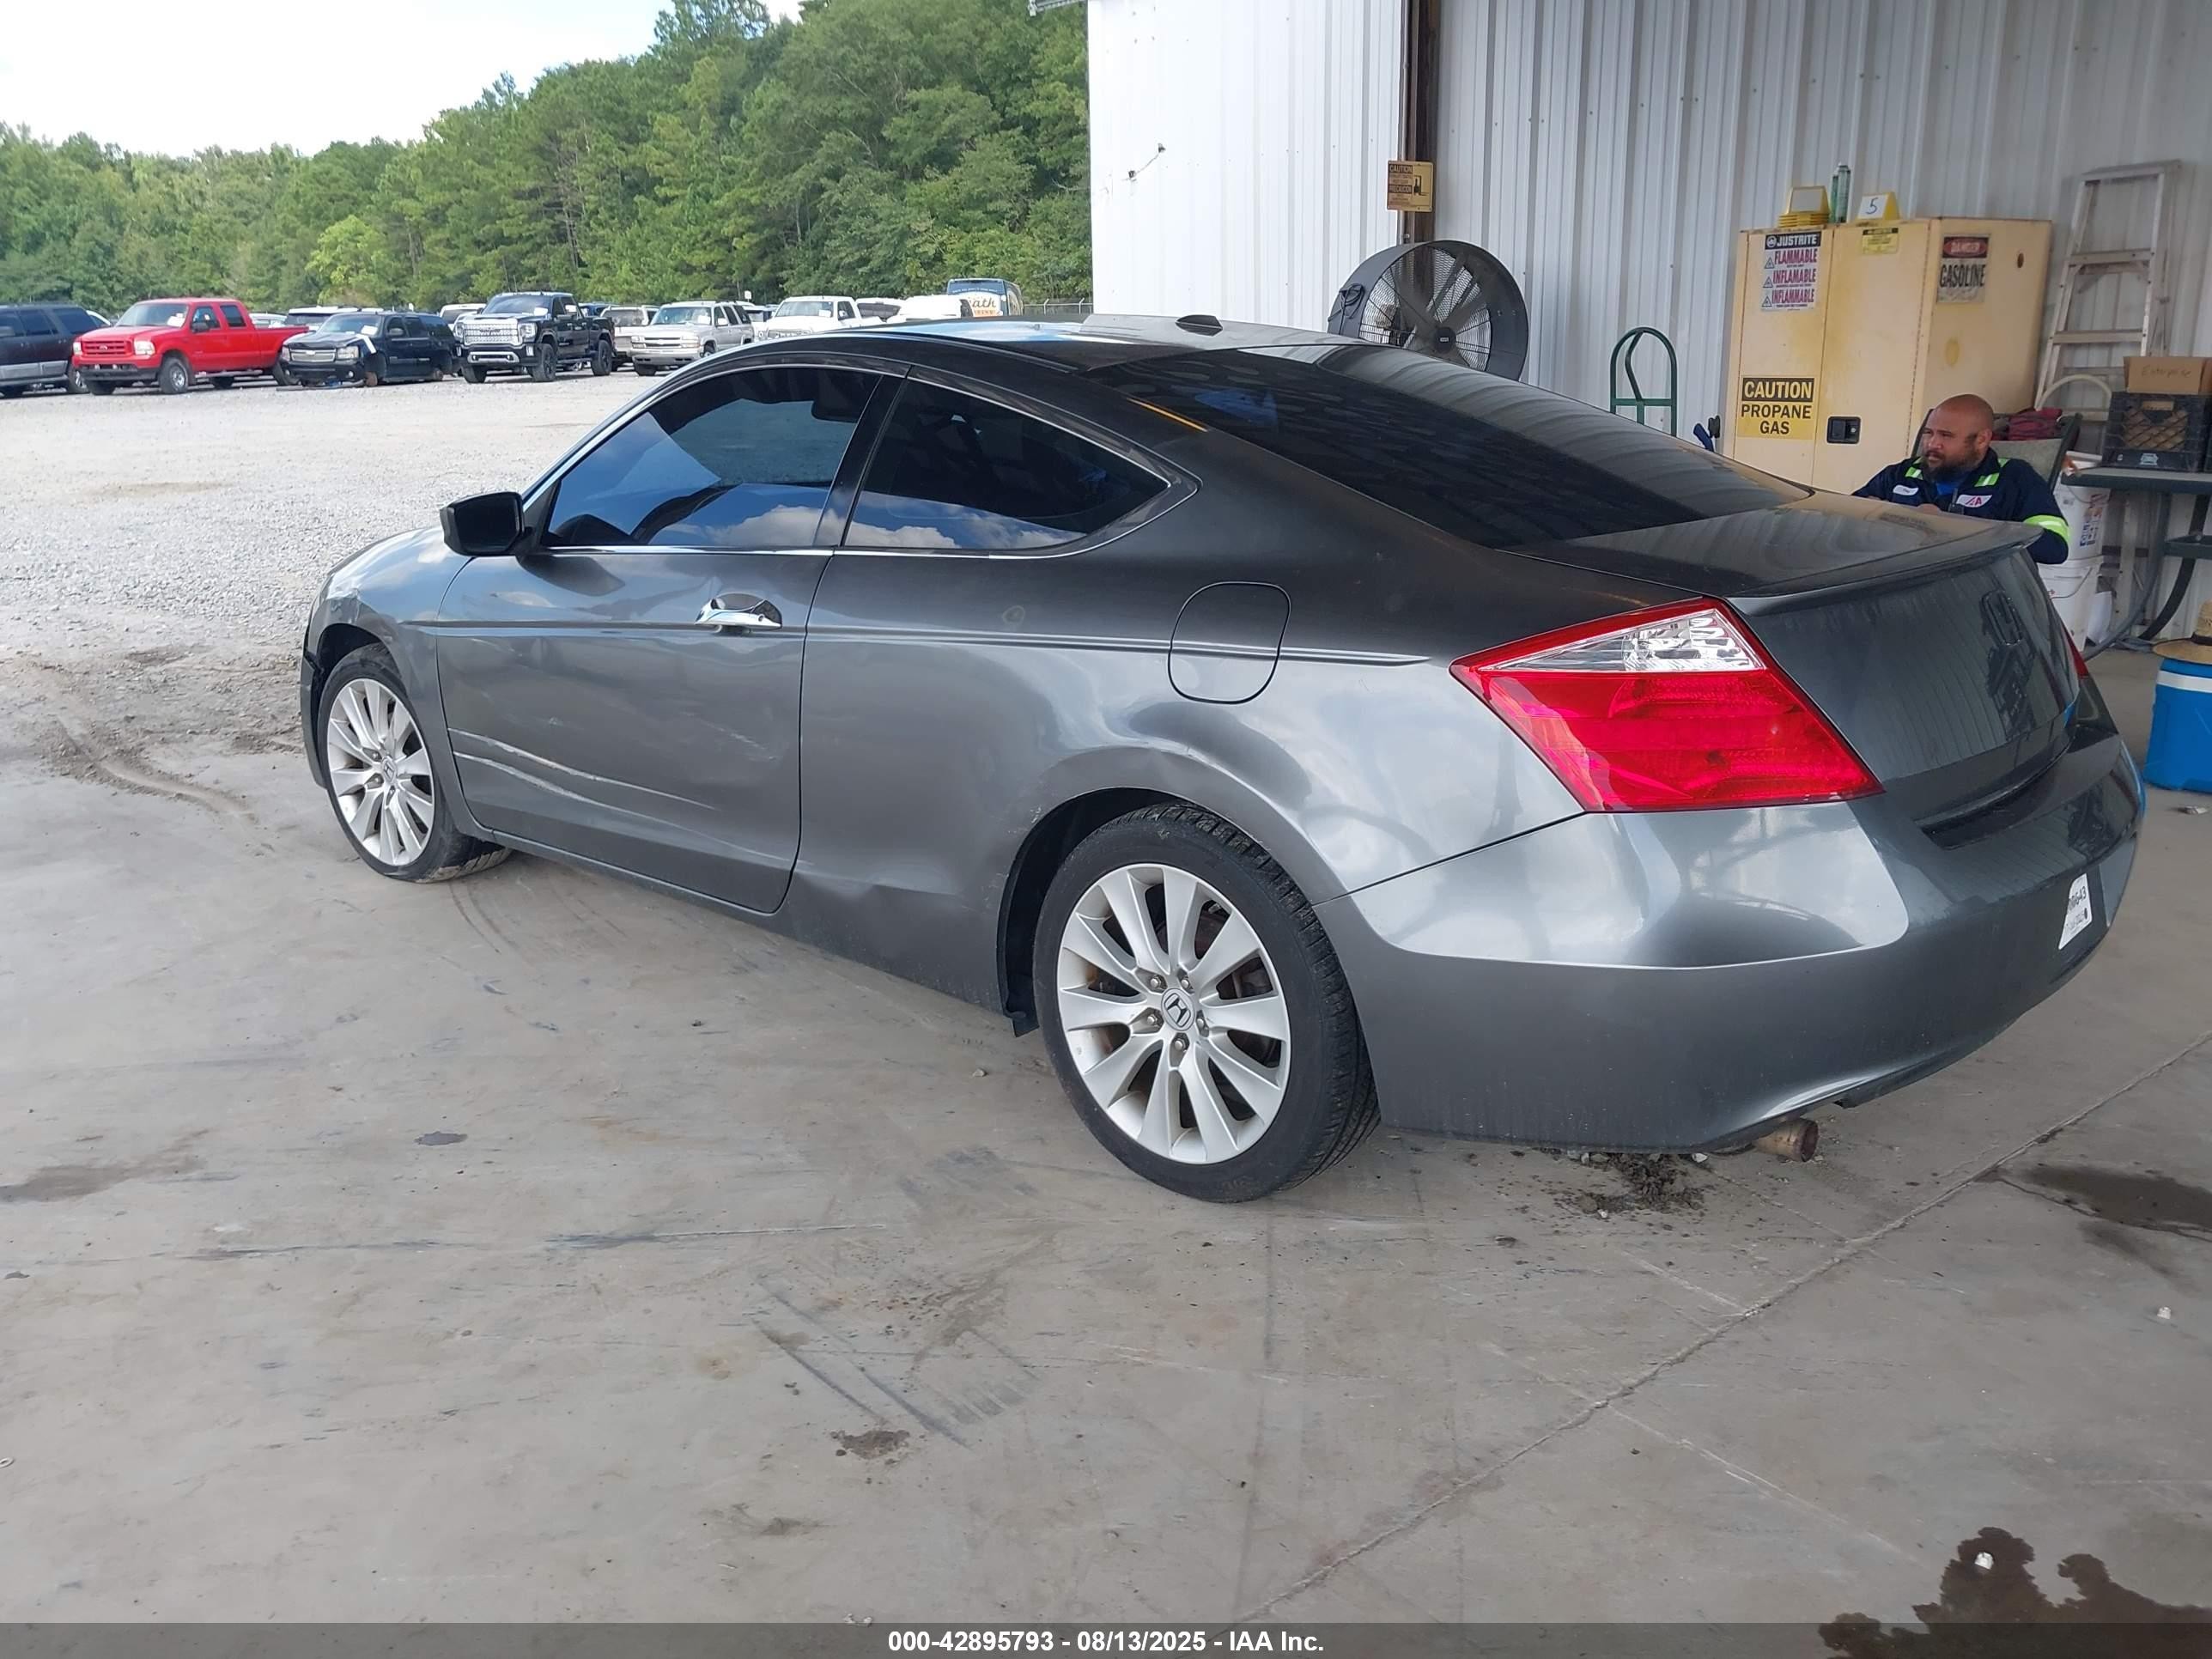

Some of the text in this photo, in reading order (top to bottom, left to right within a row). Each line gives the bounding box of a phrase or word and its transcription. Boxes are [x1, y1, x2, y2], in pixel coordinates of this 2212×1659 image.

[1865, 197, 1879, 215] 5
[1777, 234, 1818, 246] JUSTRITE
[1774, 248, 1818, 264] FLAMMABLE
[1772, 268, 1817, 284] INFLAMABLE
[1940, 264, 1986, 288] GASOLINE
[969, 297, 997, 308] ath
[1771, 289, 1815, 304] INFLAMMABLE
[1744, 380, 1812, 399] CAUTION
[1741, 404, 1812, 419] PROPANE
[1759, 420, 1790, 434] GAS
